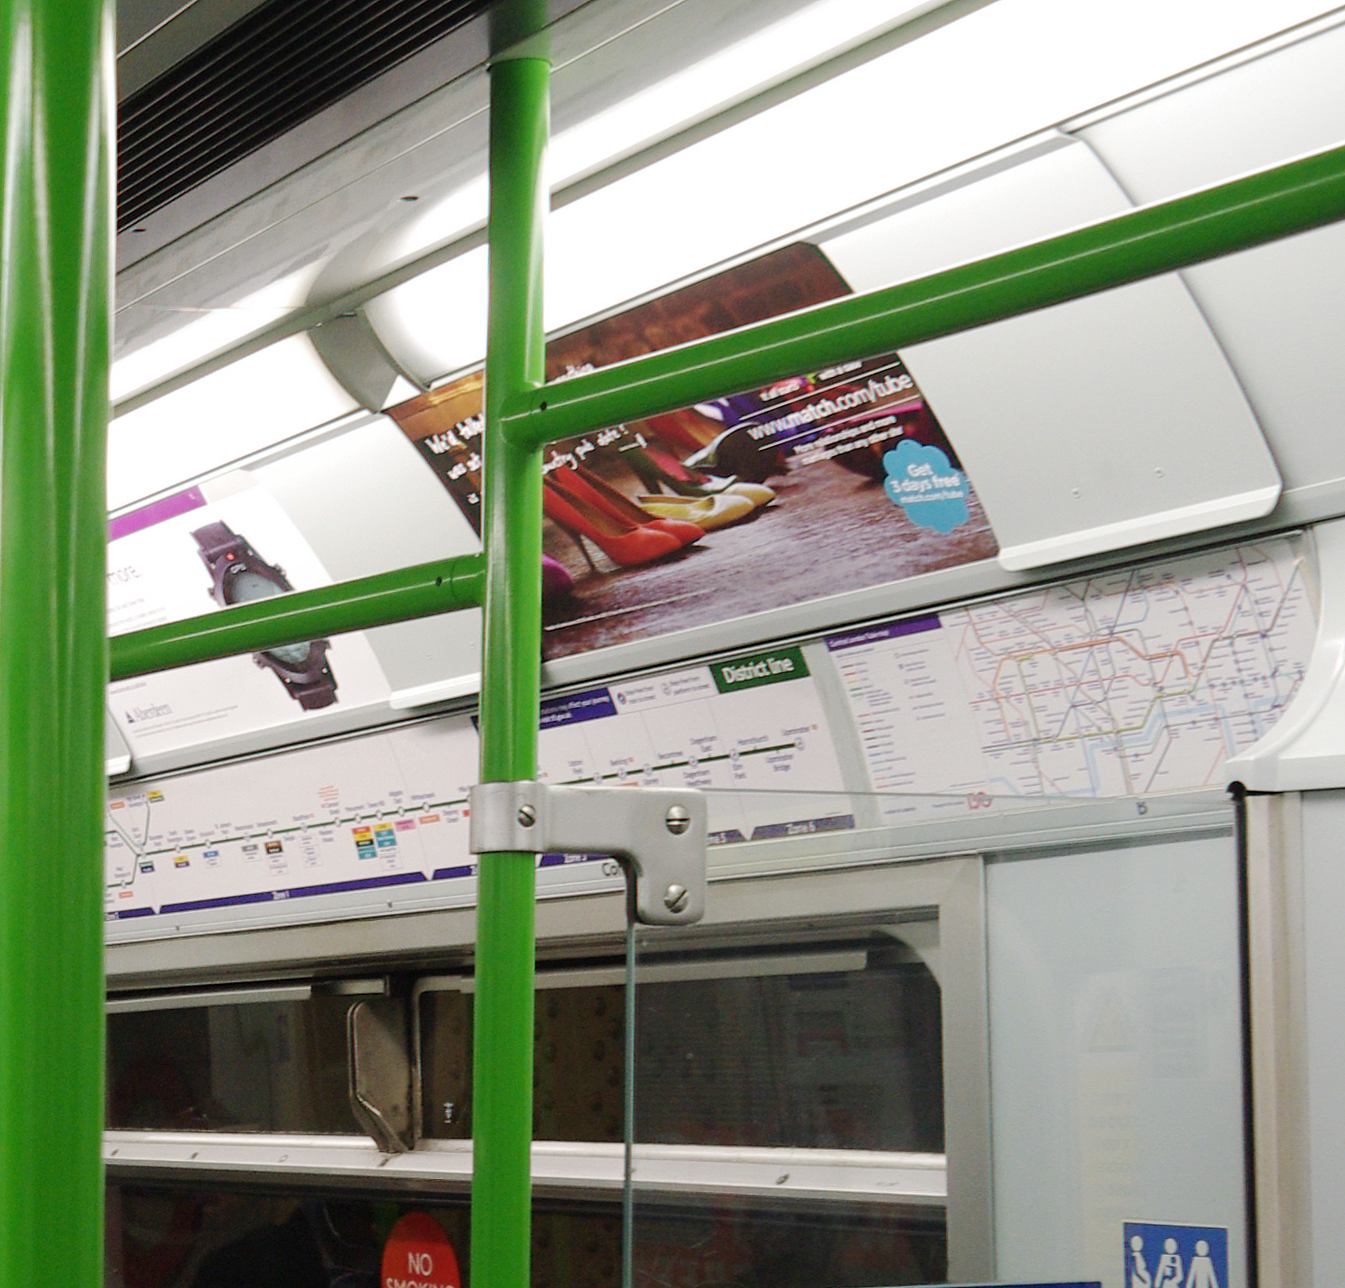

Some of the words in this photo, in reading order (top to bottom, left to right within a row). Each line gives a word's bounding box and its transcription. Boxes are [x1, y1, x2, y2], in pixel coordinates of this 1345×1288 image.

[746, 374, 913, 440] www.match.com/tube
[905, 460, 934, 479] Get
[888, 479, 902, 494] 3
[899, 473, 933, 496] days
[721, 662, 768, 684] District
[768, 656, 795, 675] line
[408, 1252, 433, 1276] NO
